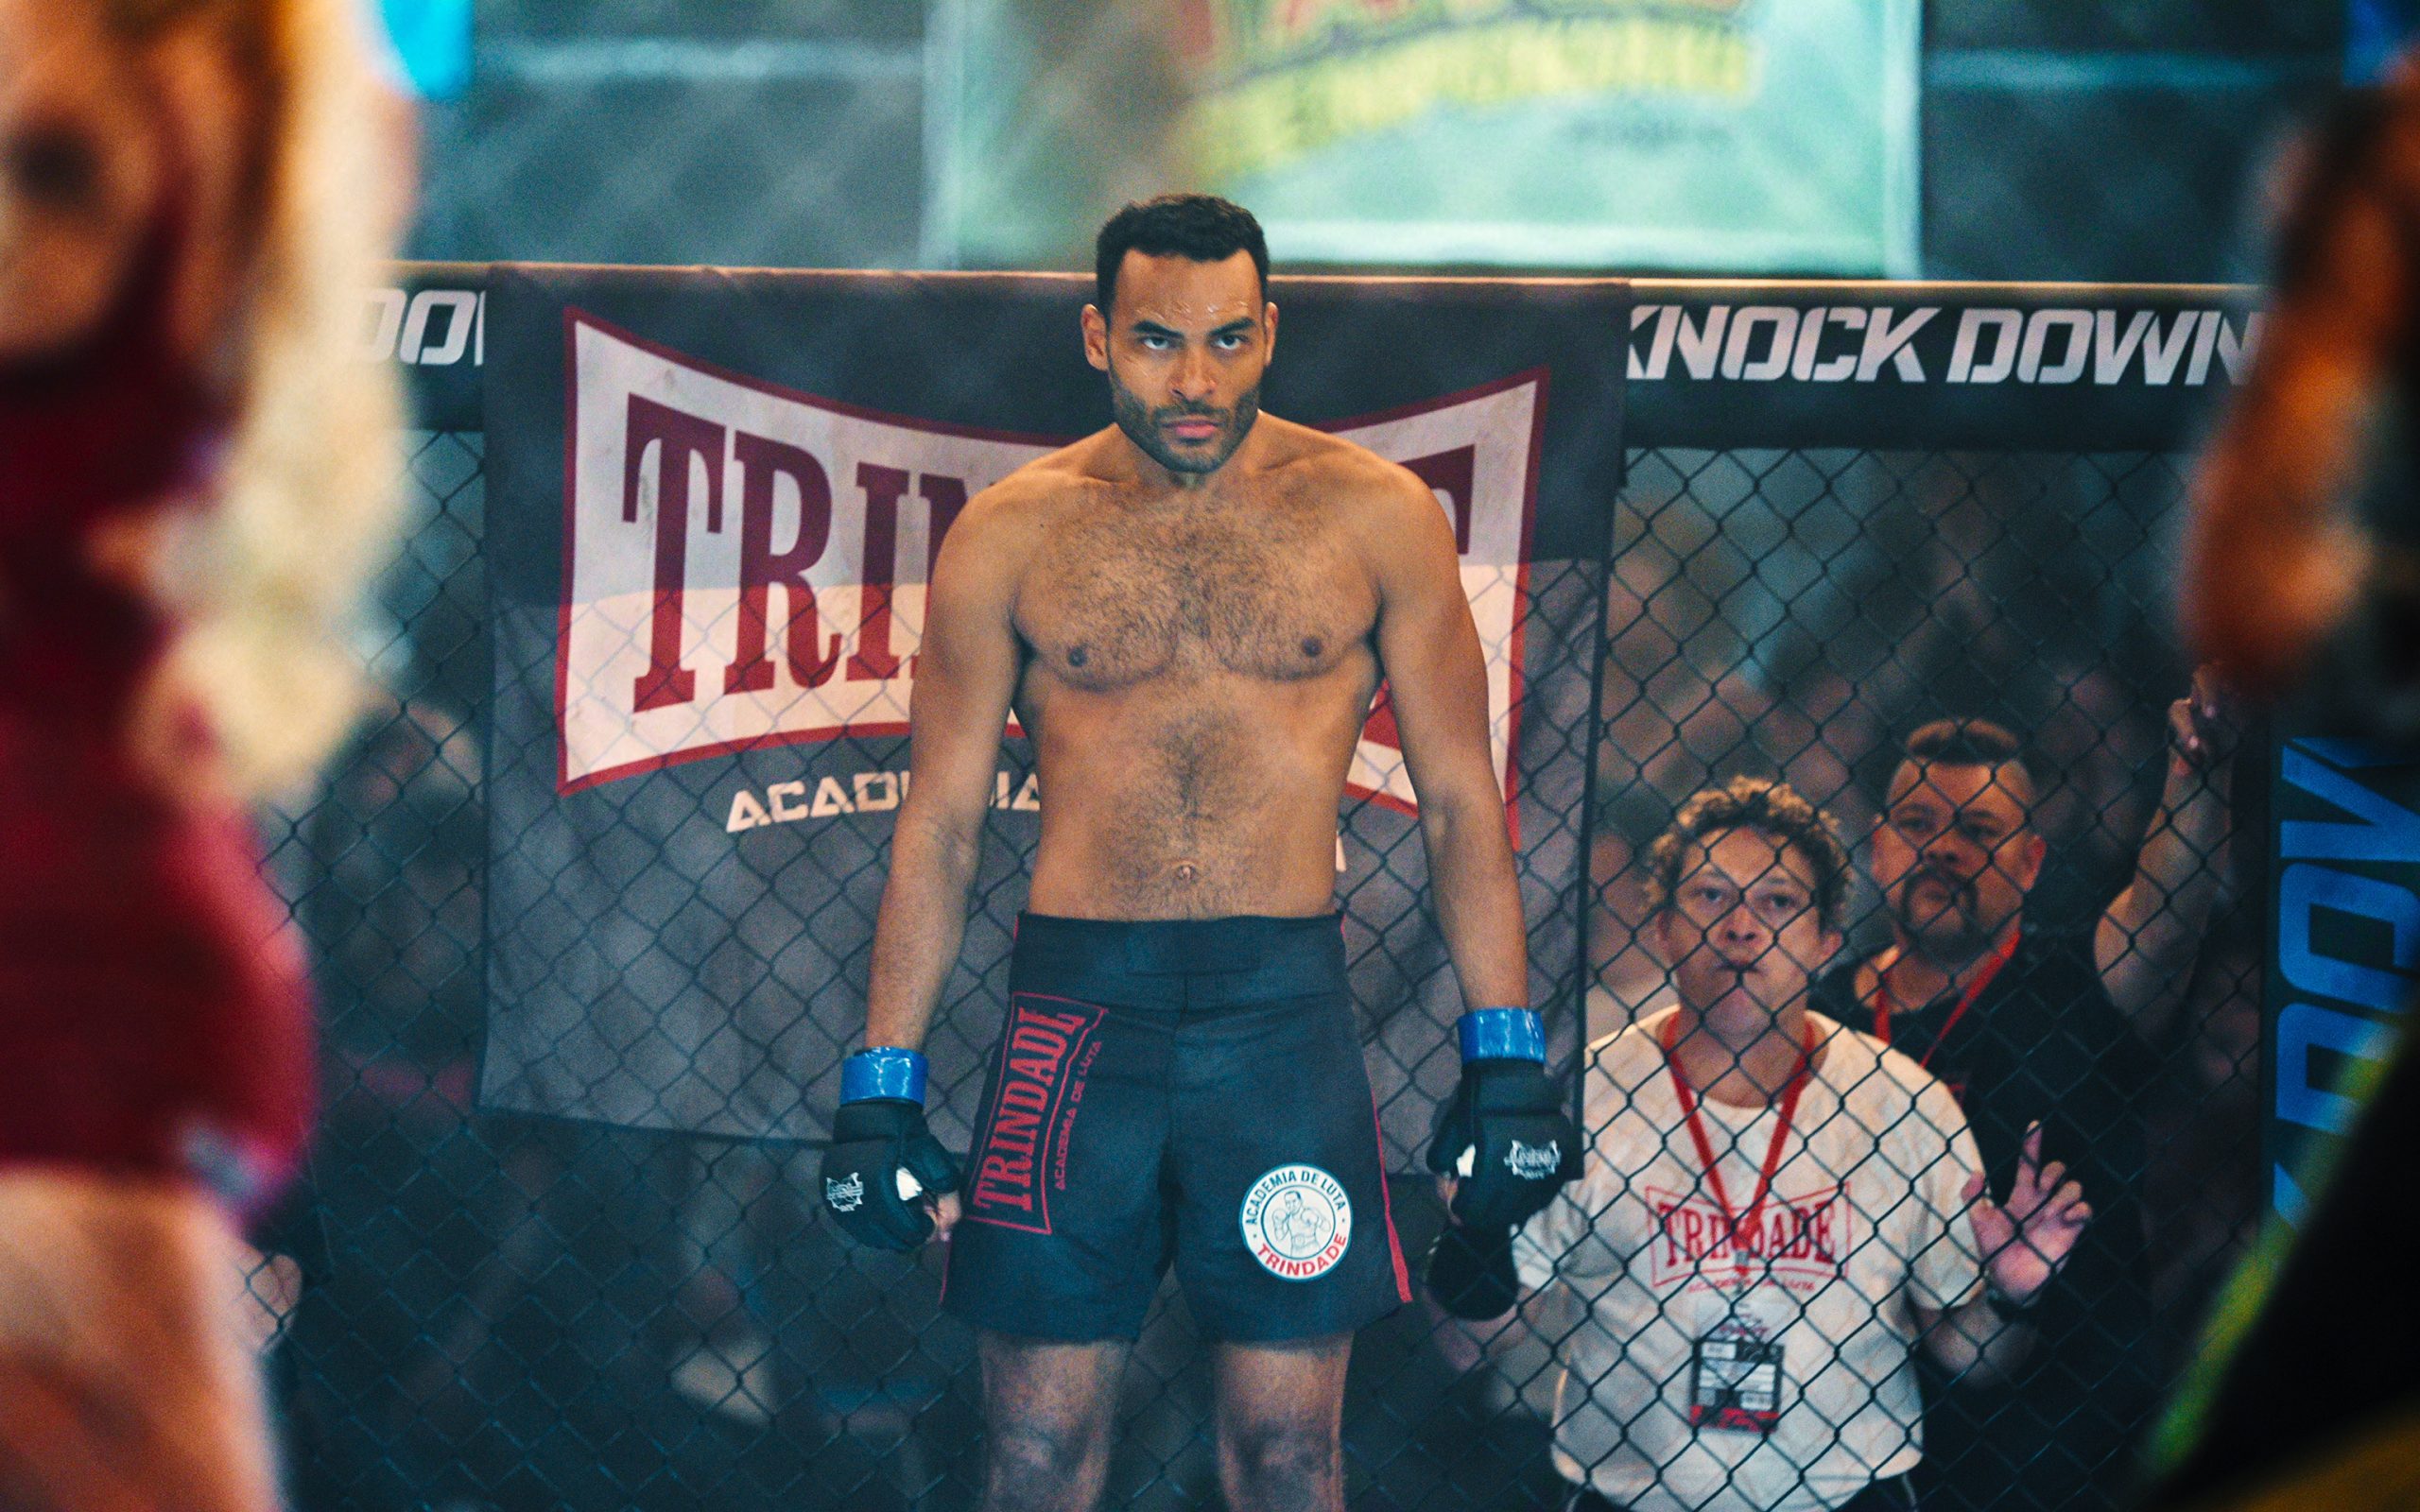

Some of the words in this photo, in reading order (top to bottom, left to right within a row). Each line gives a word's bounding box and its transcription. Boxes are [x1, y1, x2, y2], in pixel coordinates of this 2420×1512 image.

[1945, 309, 2268, 386] DOWN
[726, 770, 1040, 833] ACADIA
[1070, 1080, 1085, 1104] DE
[1078, 1040, 1102, 1076] LUTA
[1245, 1170, 1298, 1226] ACADEMIA
[1301, 1170, 1320, 1185] DE
[1321, 1177, 1347, 1211] LUTA
[1257, 1232, 1347, 1277] TRINDADE
